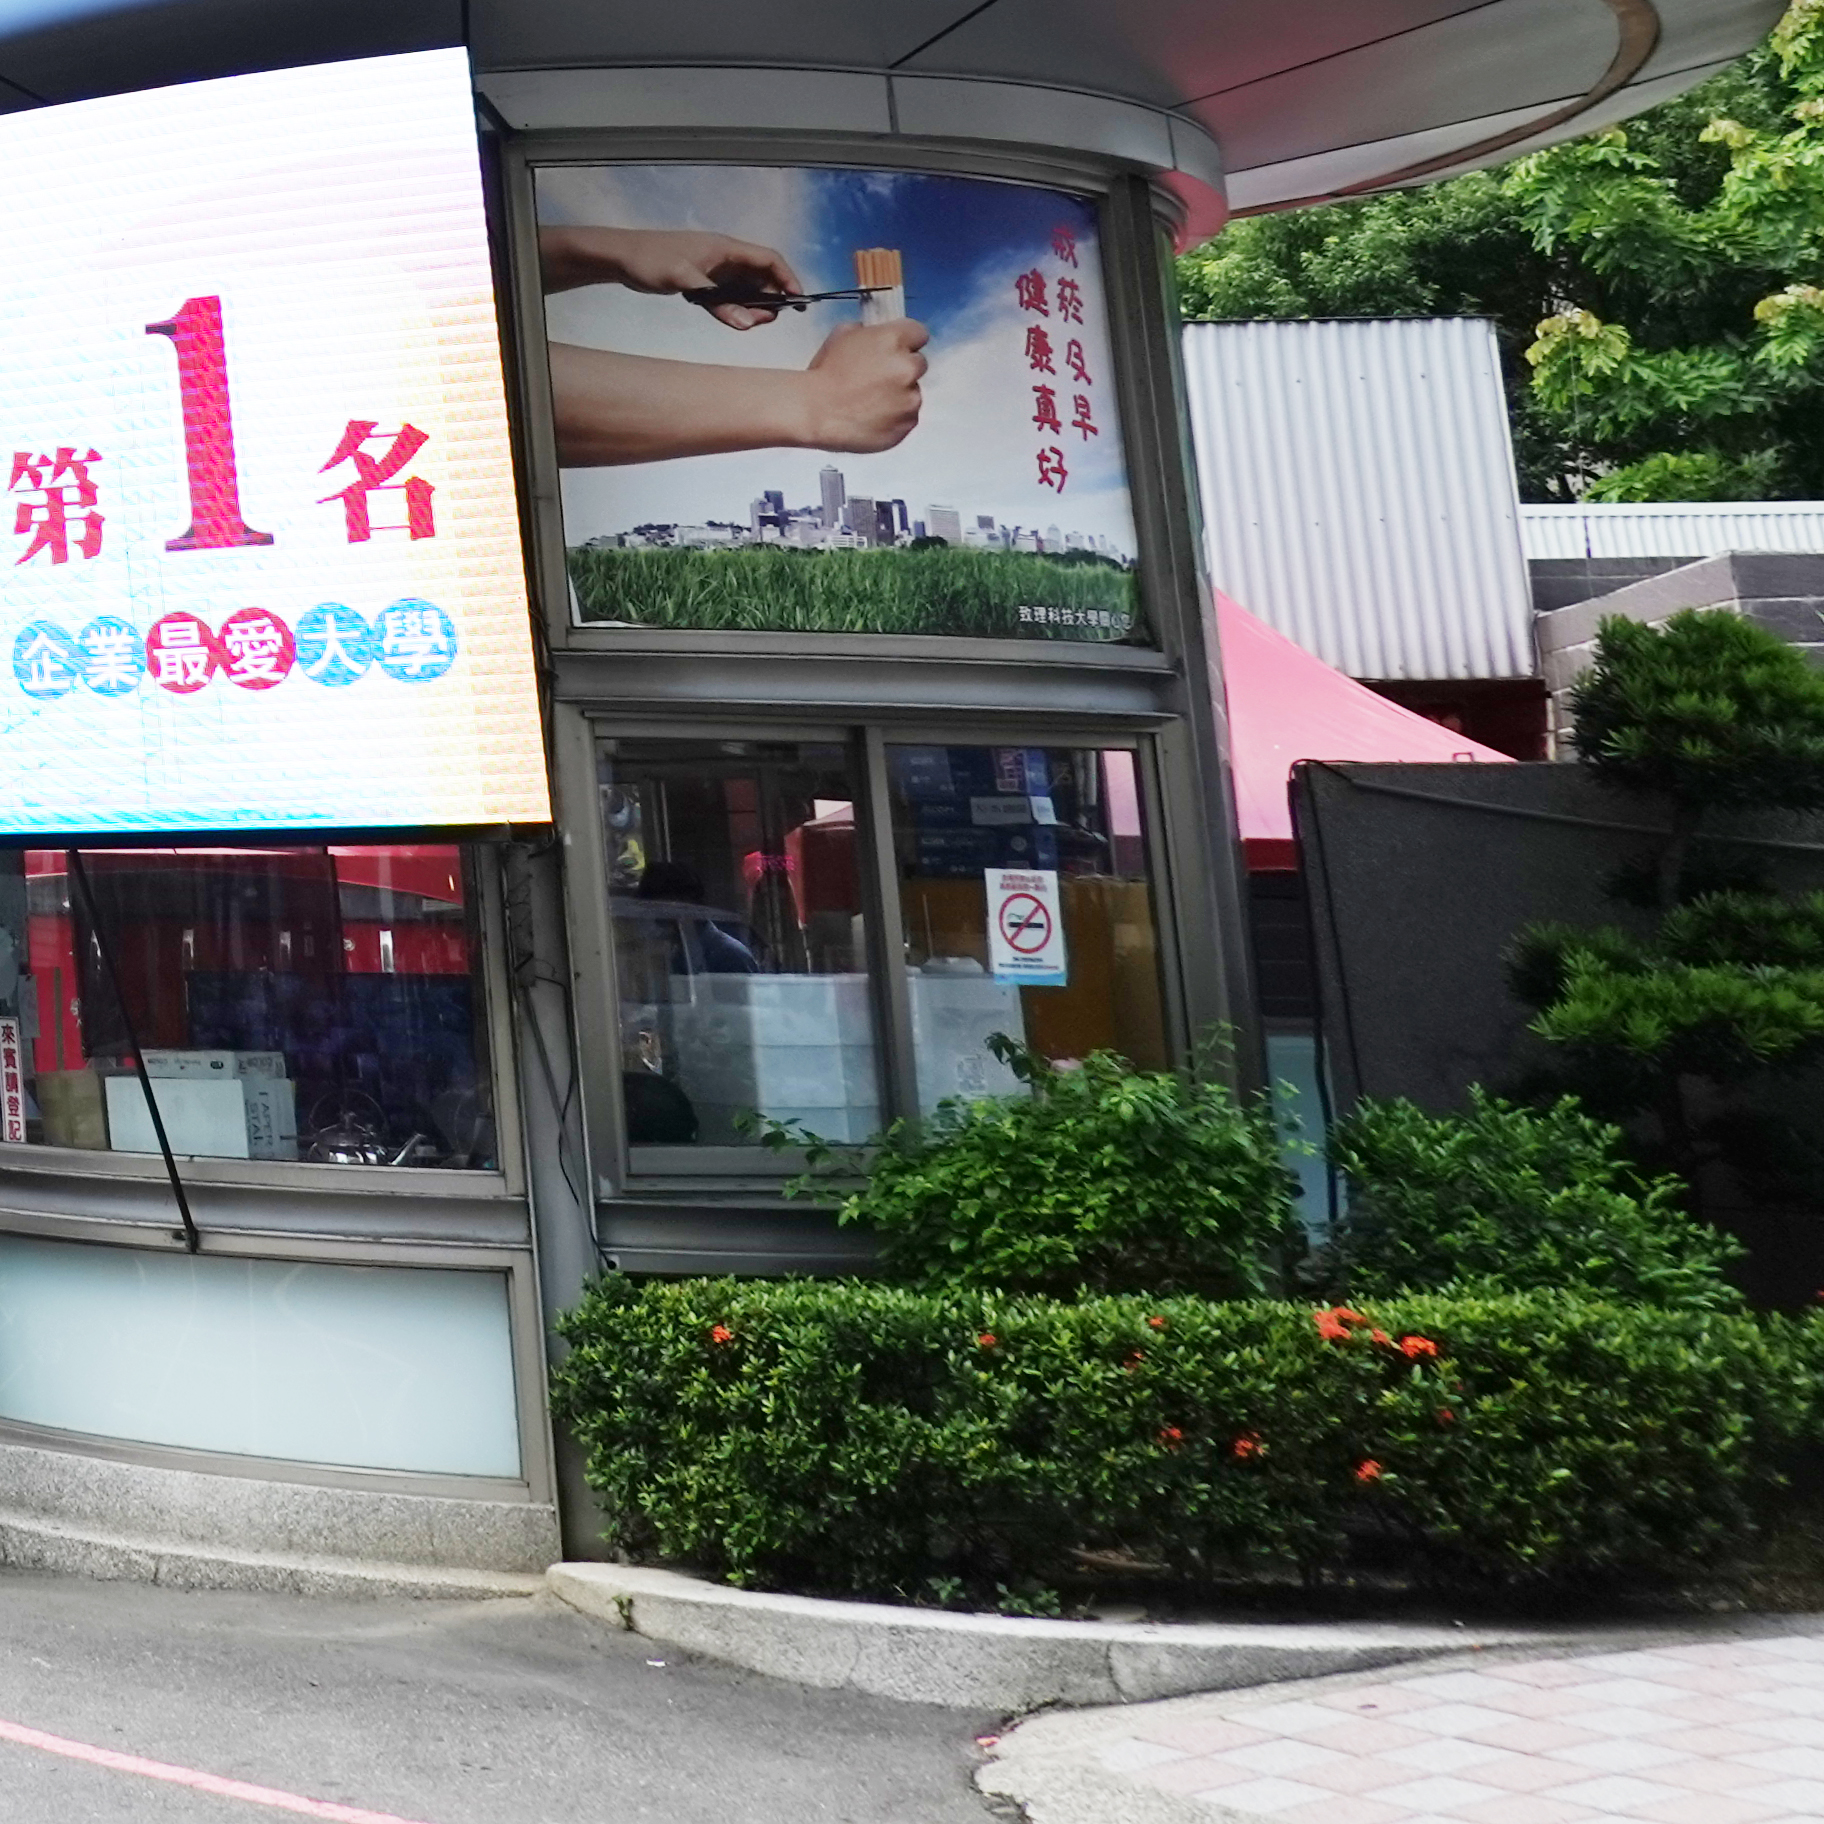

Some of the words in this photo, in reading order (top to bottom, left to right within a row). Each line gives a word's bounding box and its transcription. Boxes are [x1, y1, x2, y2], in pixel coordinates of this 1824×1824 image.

[7, 294, 436, 567] 第1名
[1015, 267, 1069, 494] 健康真好
[15, 603, 453, 697] 企業最愛大學
[0, 1022, 22, 1142] 來賓請登記
